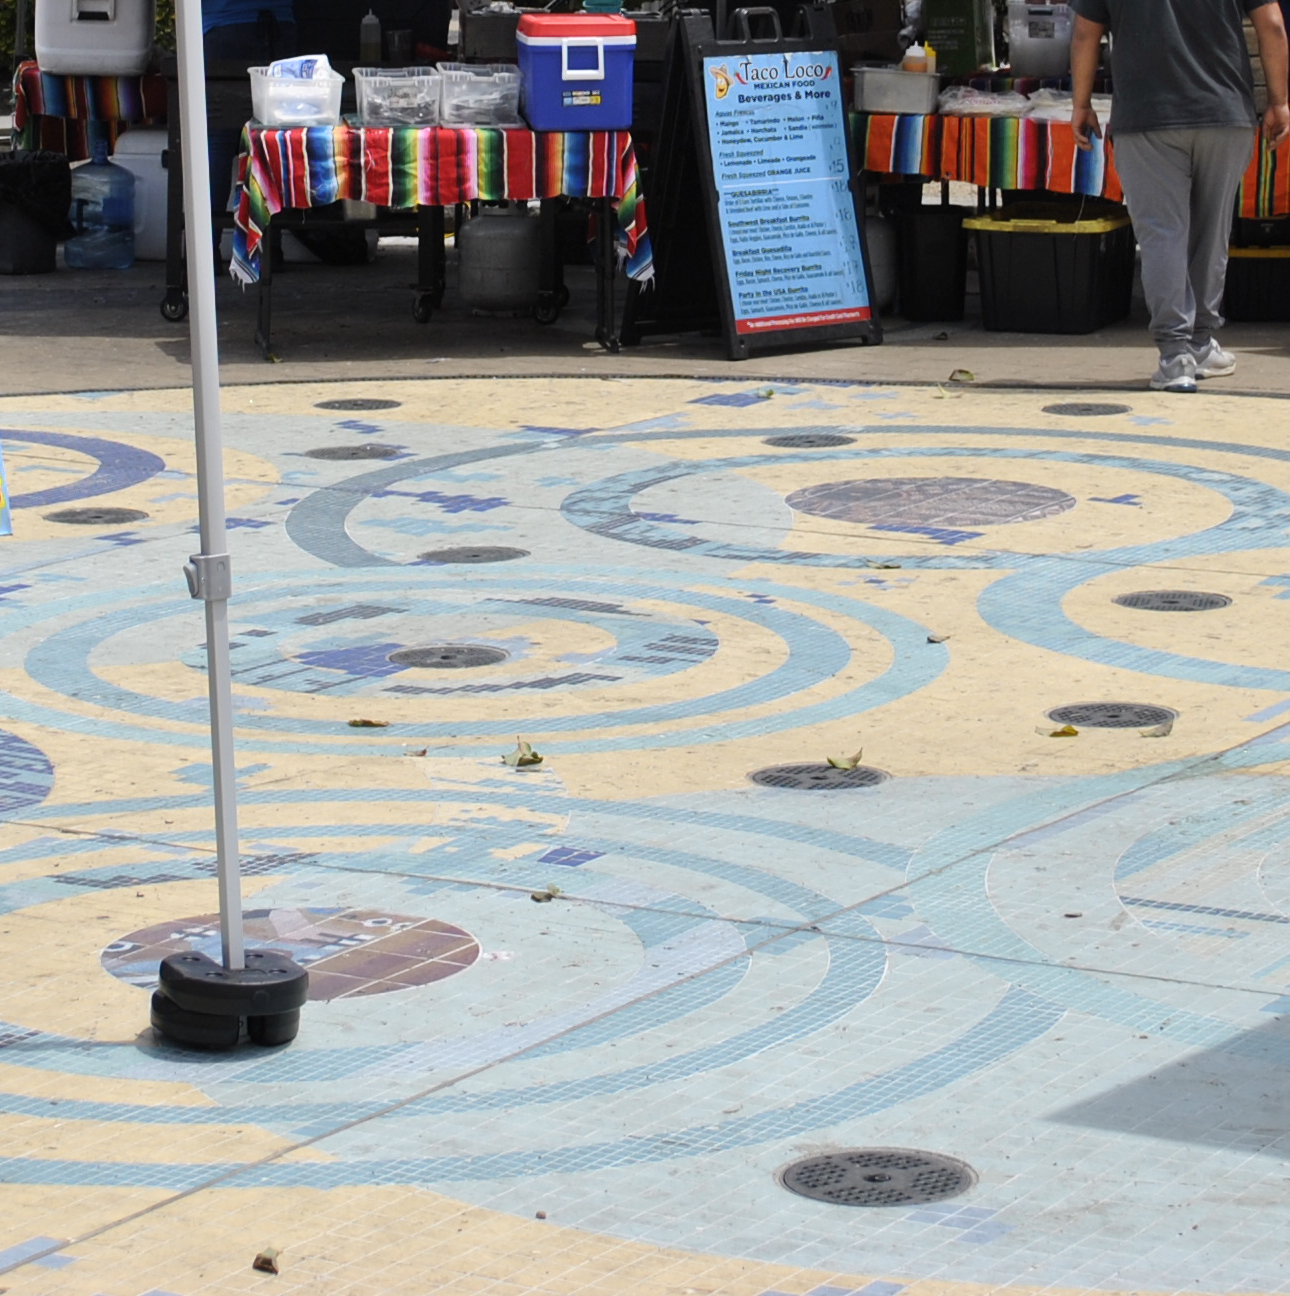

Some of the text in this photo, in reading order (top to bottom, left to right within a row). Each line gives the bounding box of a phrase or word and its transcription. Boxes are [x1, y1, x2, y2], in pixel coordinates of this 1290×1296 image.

[739, 57, 823, 81] Taco Loco
[753, 79, 815, 89] MEXICAN FOOD
[737, 89, 830, 104] Beverages & More
[728, 219, 758, 227] Southwest
[759, 216, 787, 224] Breakfast
[732, 245, 791, 256] Breakfast Quesadilla
[735, 270, 753, 278] Friday
[755, 268, 771, 276] Night
[773, 265, 799, 274] Recovery
